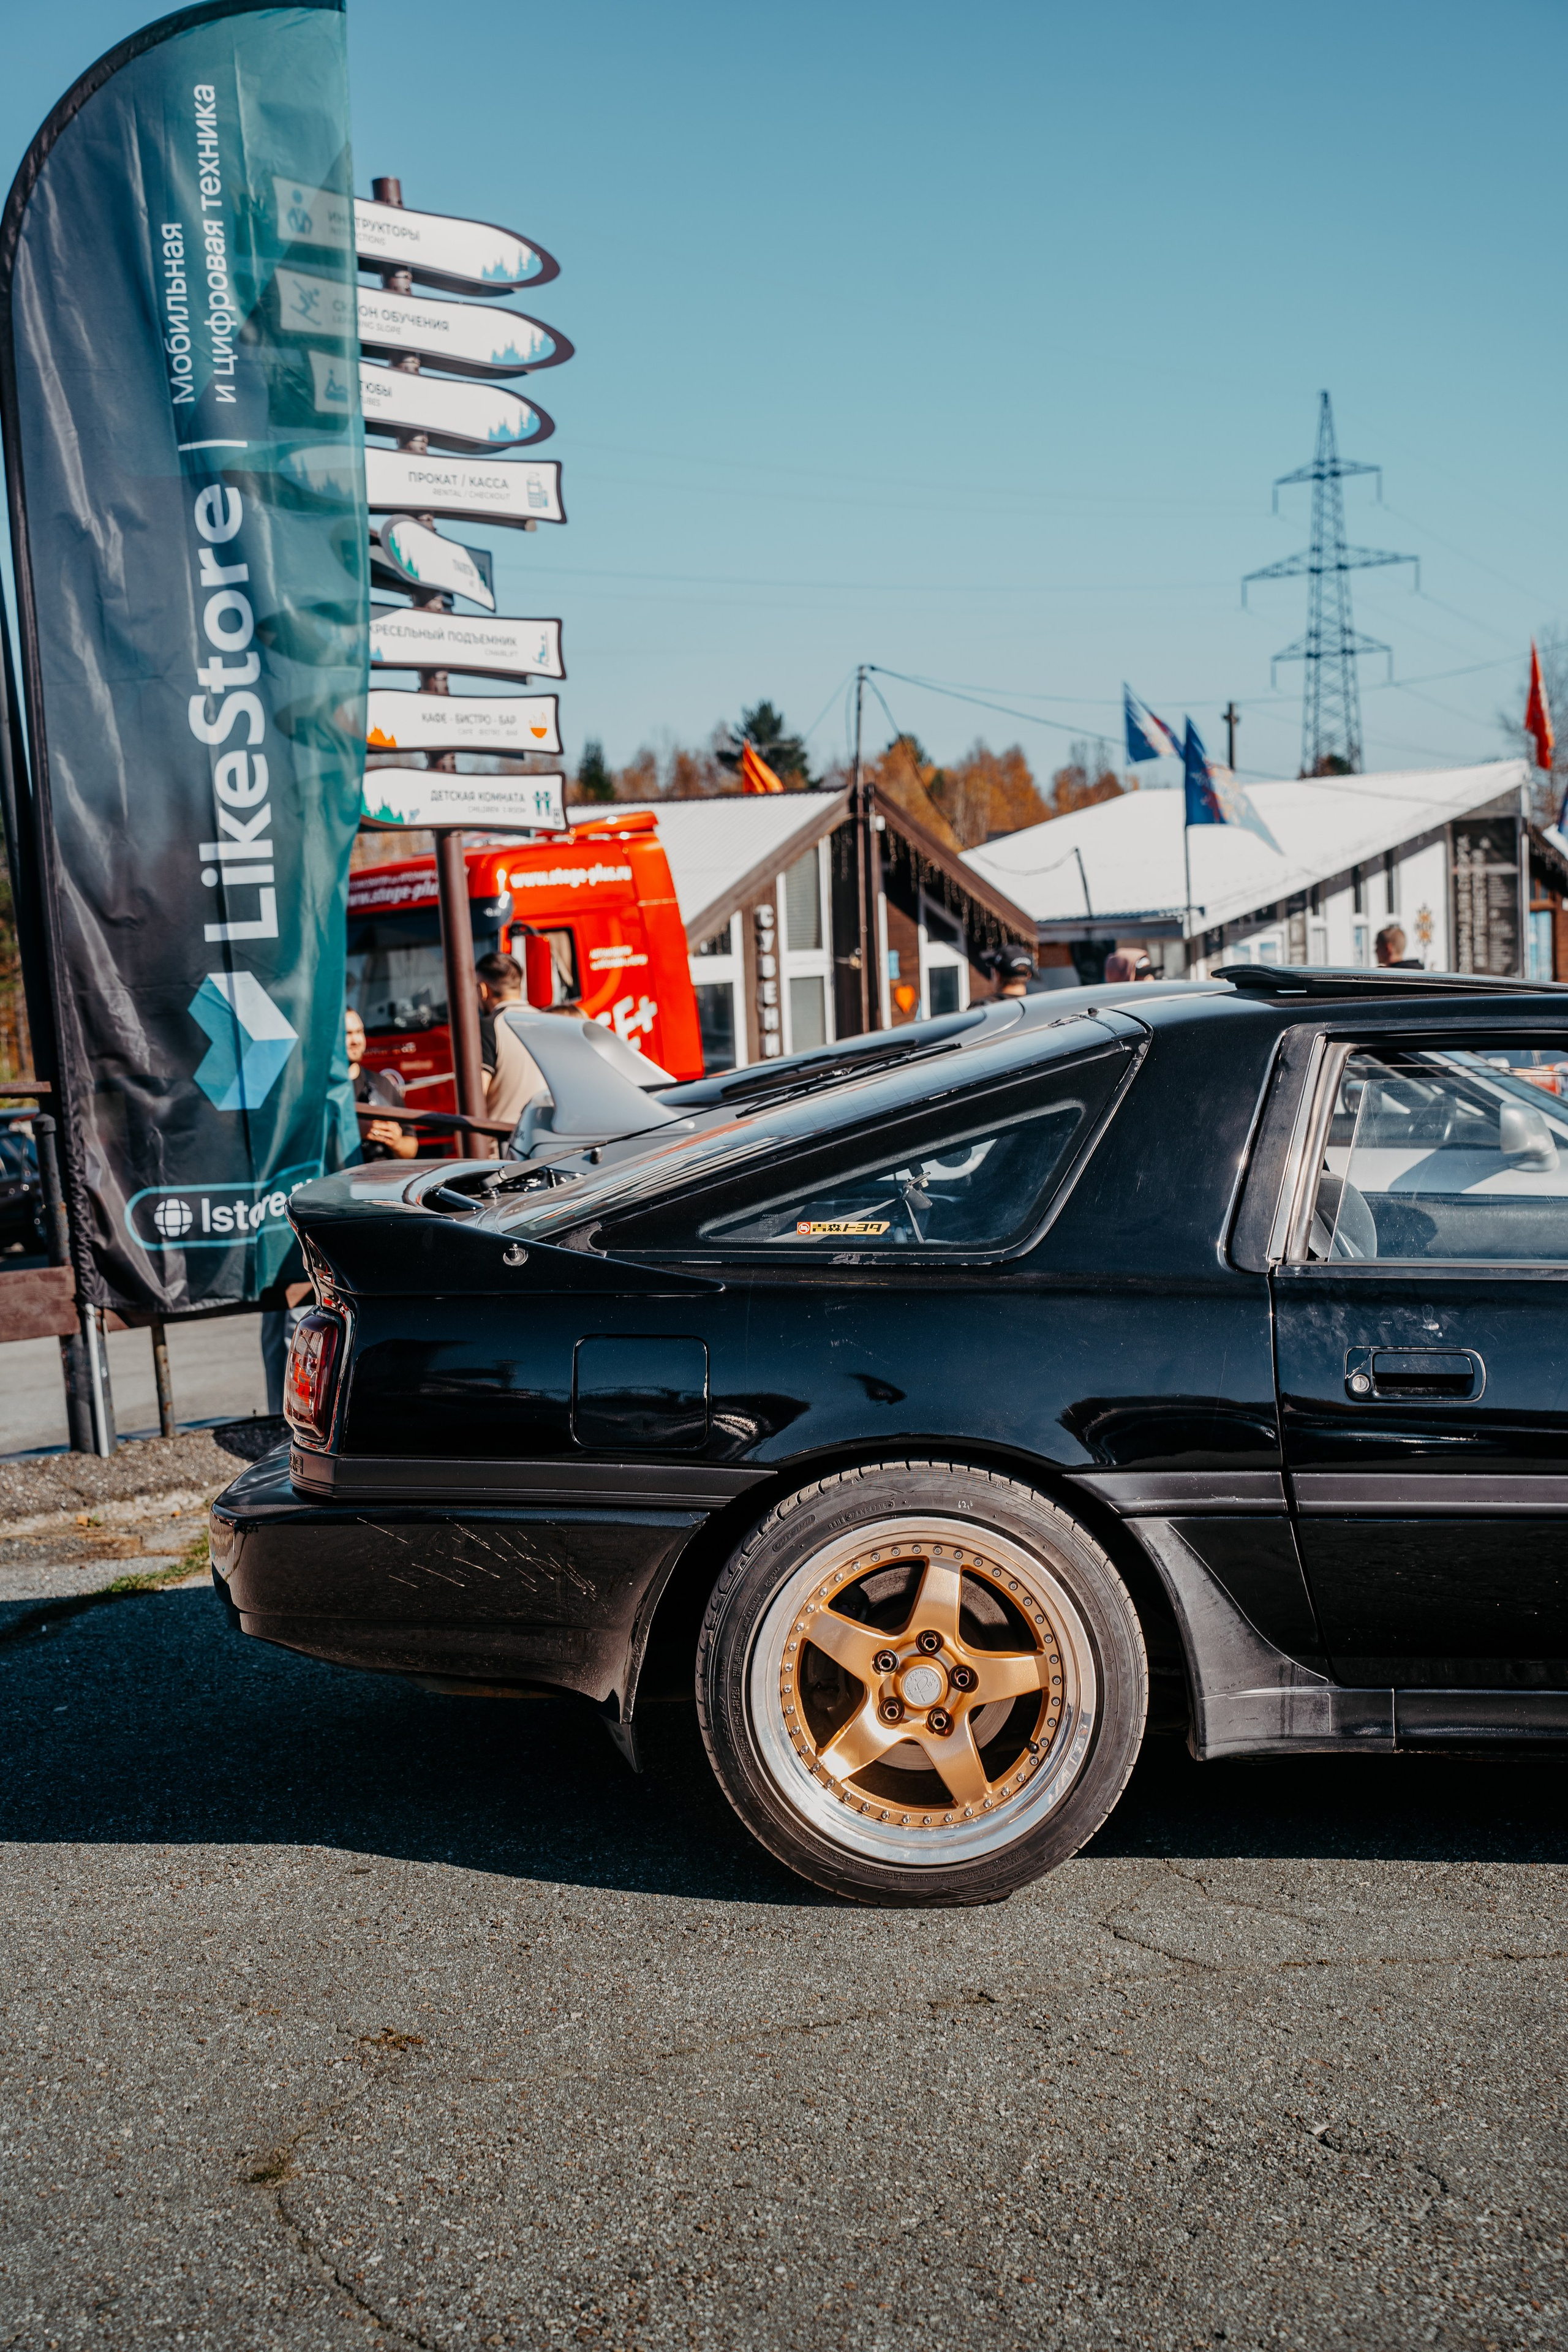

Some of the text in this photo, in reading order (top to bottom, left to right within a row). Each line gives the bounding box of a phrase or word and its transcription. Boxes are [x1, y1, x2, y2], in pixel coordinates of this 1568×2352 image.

[327, 209, 420, 242] ИНТРУКТОРЫ
[194, 84, 238, 404] и цифровая техника
[162, 223, 195, 404] Мобильная
[381, 309, 450, 331] ОБУЧЕНИЯ
[408, 471, 457, 486] ПРОКАТ
[469, 476, 509, 489] КАССА
[469, 491, 510, 500] CHECKOUT
[447, 630, 517, 647] ПОДЪЕМНИК
[187, 483, 279, 943] LikeStore
[421, 712, 447, 724] КАФЕ
[455, 712, 491, 725] БИСТРО
[499, 714, 517, 726] БАР
[431, 790, 526, 803] ДЕТСКАЯ КОМНАТА
